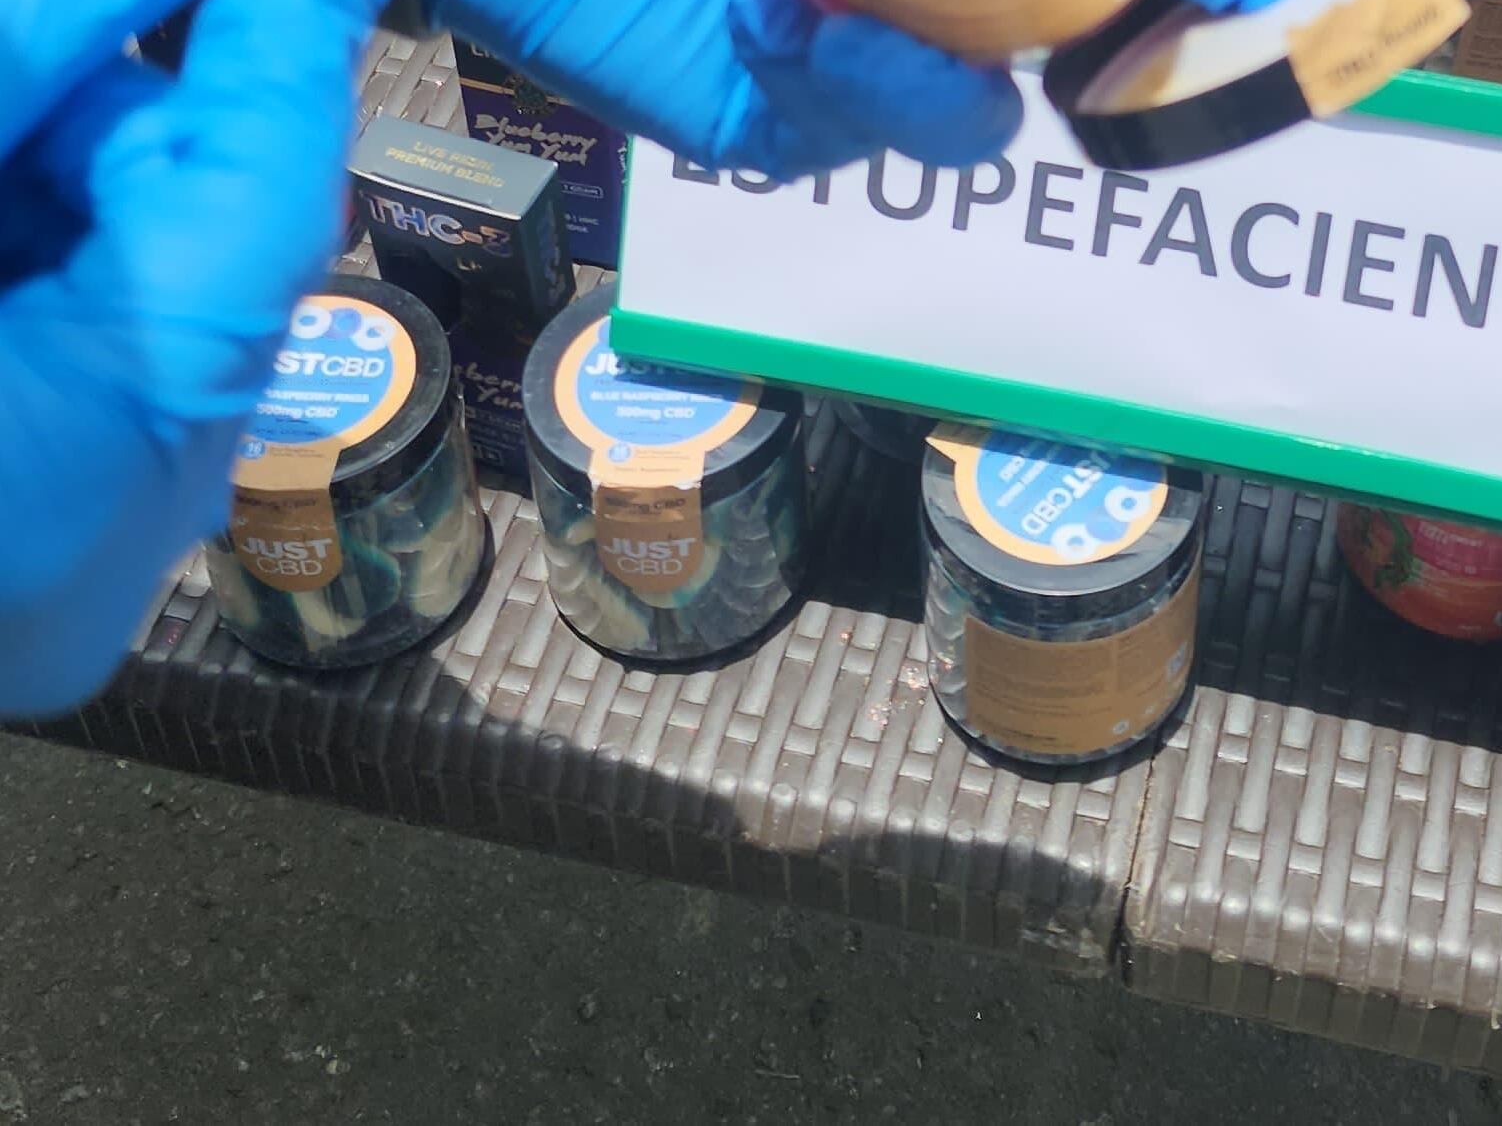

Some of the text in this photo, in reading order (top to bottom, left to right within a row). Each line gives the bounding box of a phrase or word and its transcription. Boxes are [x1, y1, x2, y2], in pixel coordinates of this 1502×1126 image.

[473, 112, 599, 154] Blueberry
[413, 140, 450, 160] LIVE
[537, 141, 589, 167] Yum
[385, 147, 506, 190] PREMIUM BLEND
[361, 192, 514, 259] THC-3
[664, 406, 697, 420] CBD
[242, 537, 334, 560] JUST
[602, 537, 697, 559] JUST
[255, 554, 325, 576] CBD
[615, 555, 684, 576] CBD
